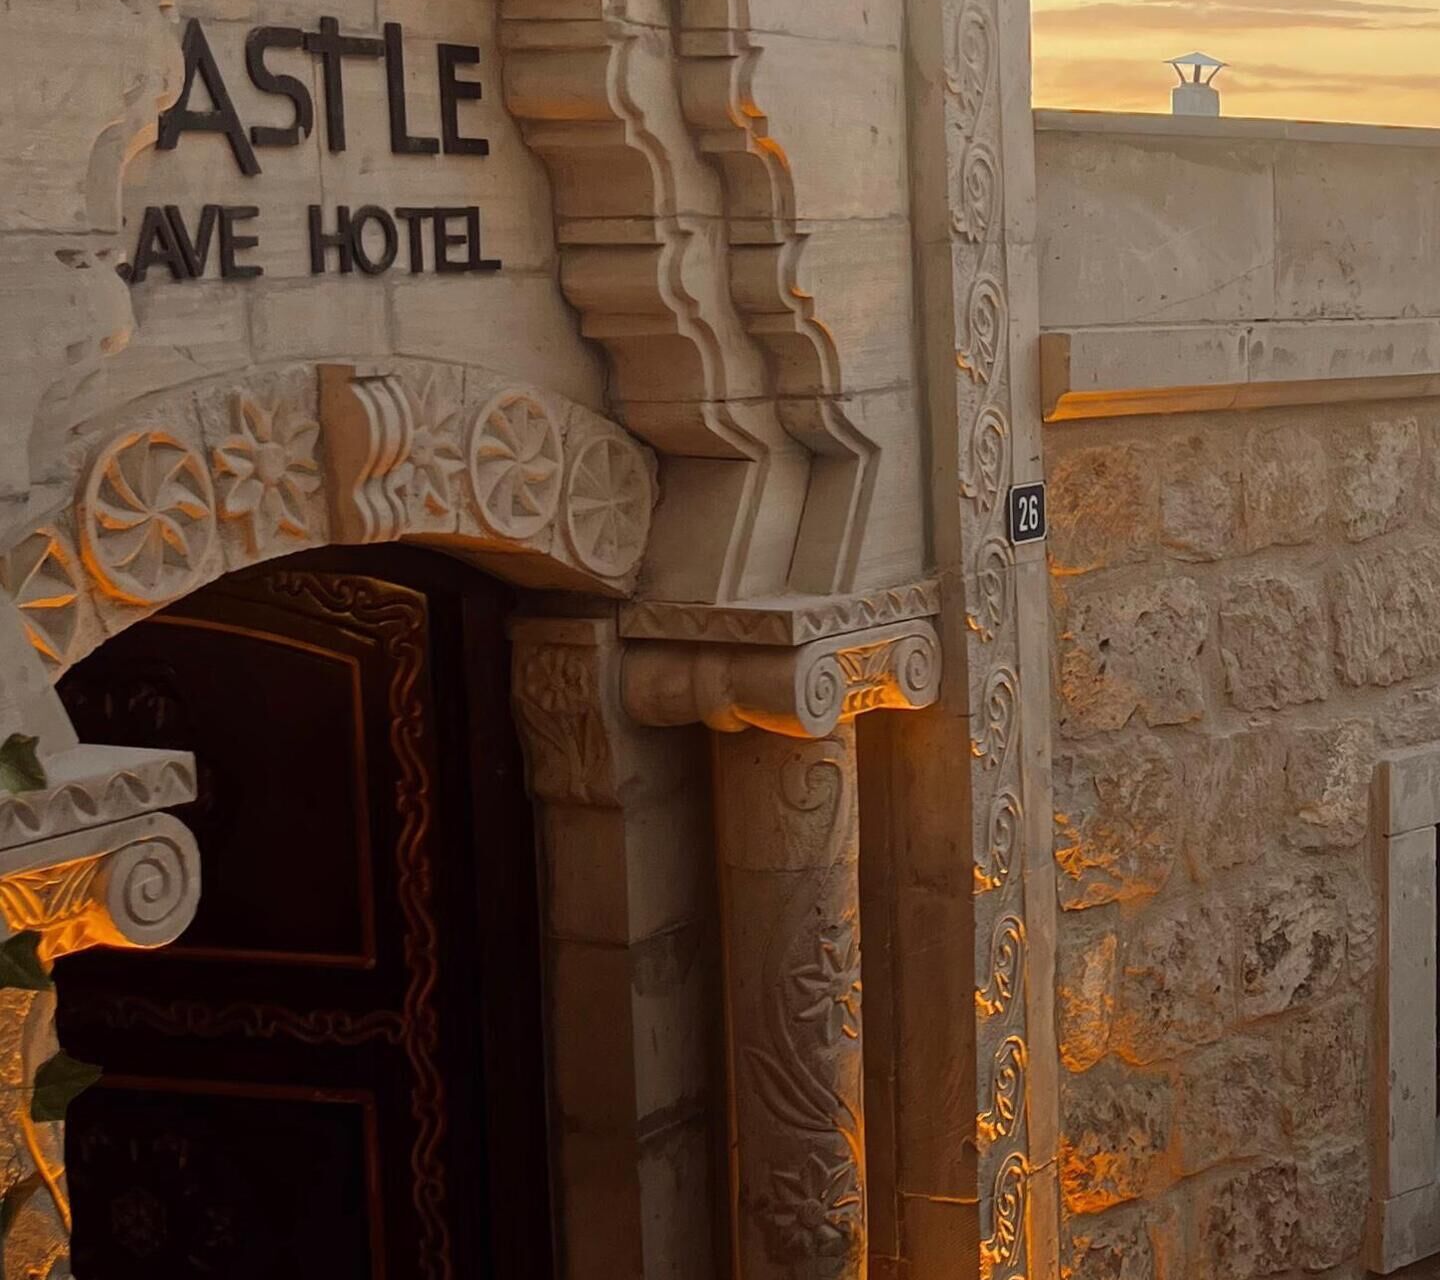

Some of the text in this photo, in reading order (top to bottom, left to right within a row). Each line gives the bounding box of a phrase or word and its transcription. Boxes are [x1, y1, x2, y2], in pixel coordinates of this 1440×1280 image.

[116, 204, 502, 283] AVE HOTEL
[1018, 495, 1039, 532] 26
